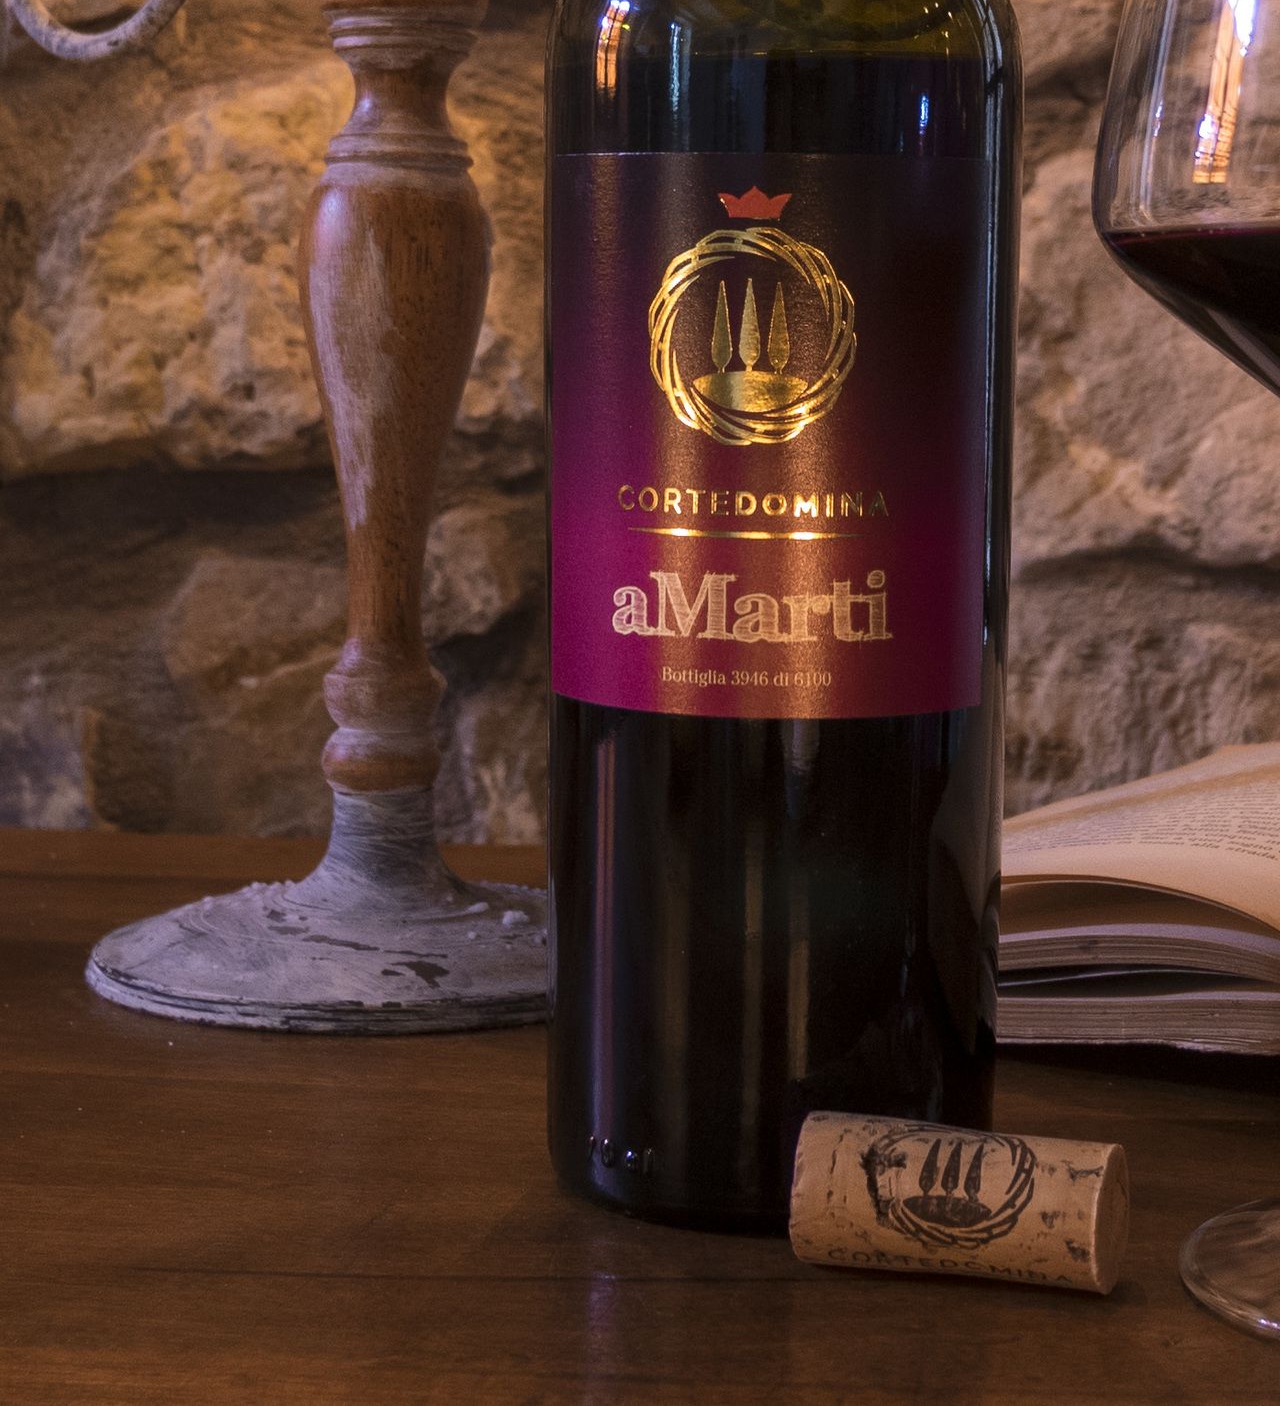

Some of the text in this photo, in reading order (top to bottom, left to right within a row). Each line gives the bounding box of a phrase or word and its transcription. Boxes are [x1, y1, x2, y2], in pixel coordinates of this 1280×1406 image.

[618, 484, 889, 518] CORTEDOMINA
[612, 569, 893, 643] aMarti
[661, 666, 832, 687] Bottiglia 3946 di 6100
